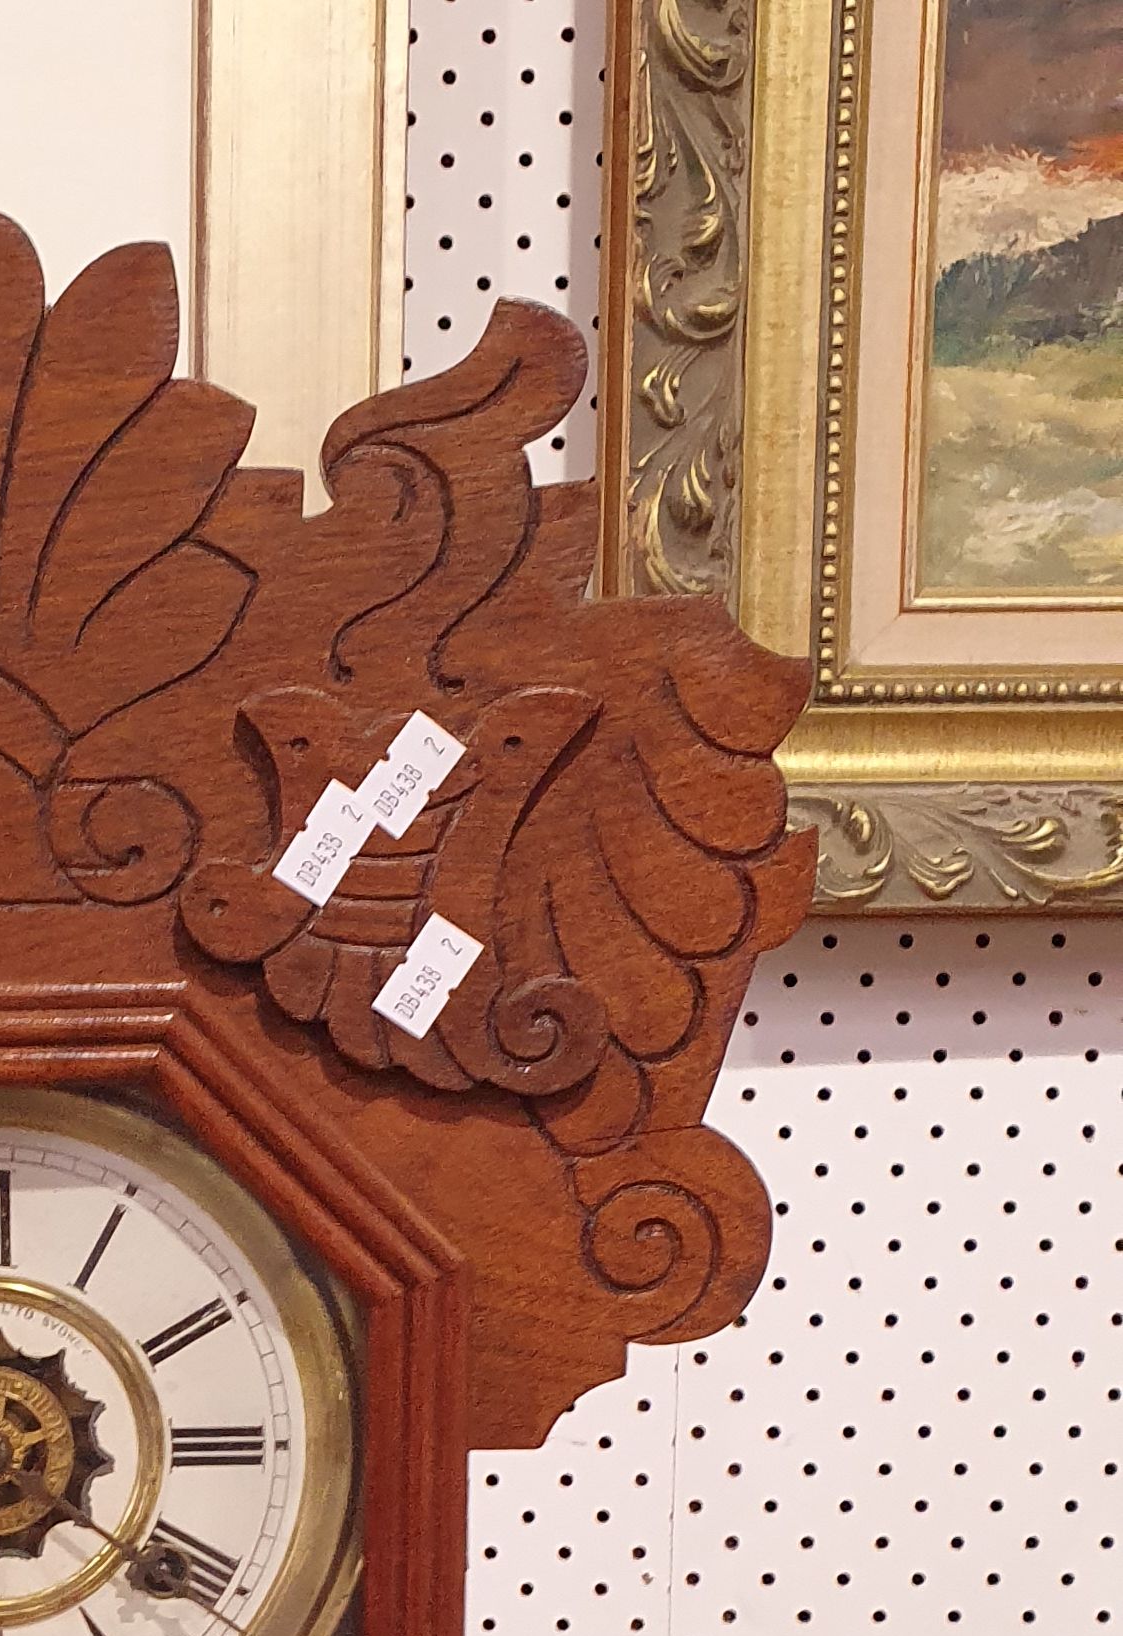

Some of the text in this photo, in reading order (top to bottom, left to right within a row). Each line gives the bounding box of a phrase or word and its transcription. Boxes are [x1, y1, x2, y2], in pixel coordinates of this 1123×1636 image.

[341, 803, 363, 824] 2
[373, 736, 445, 817] DB438 2
[393, 937, 463, 1020] DB438 2
